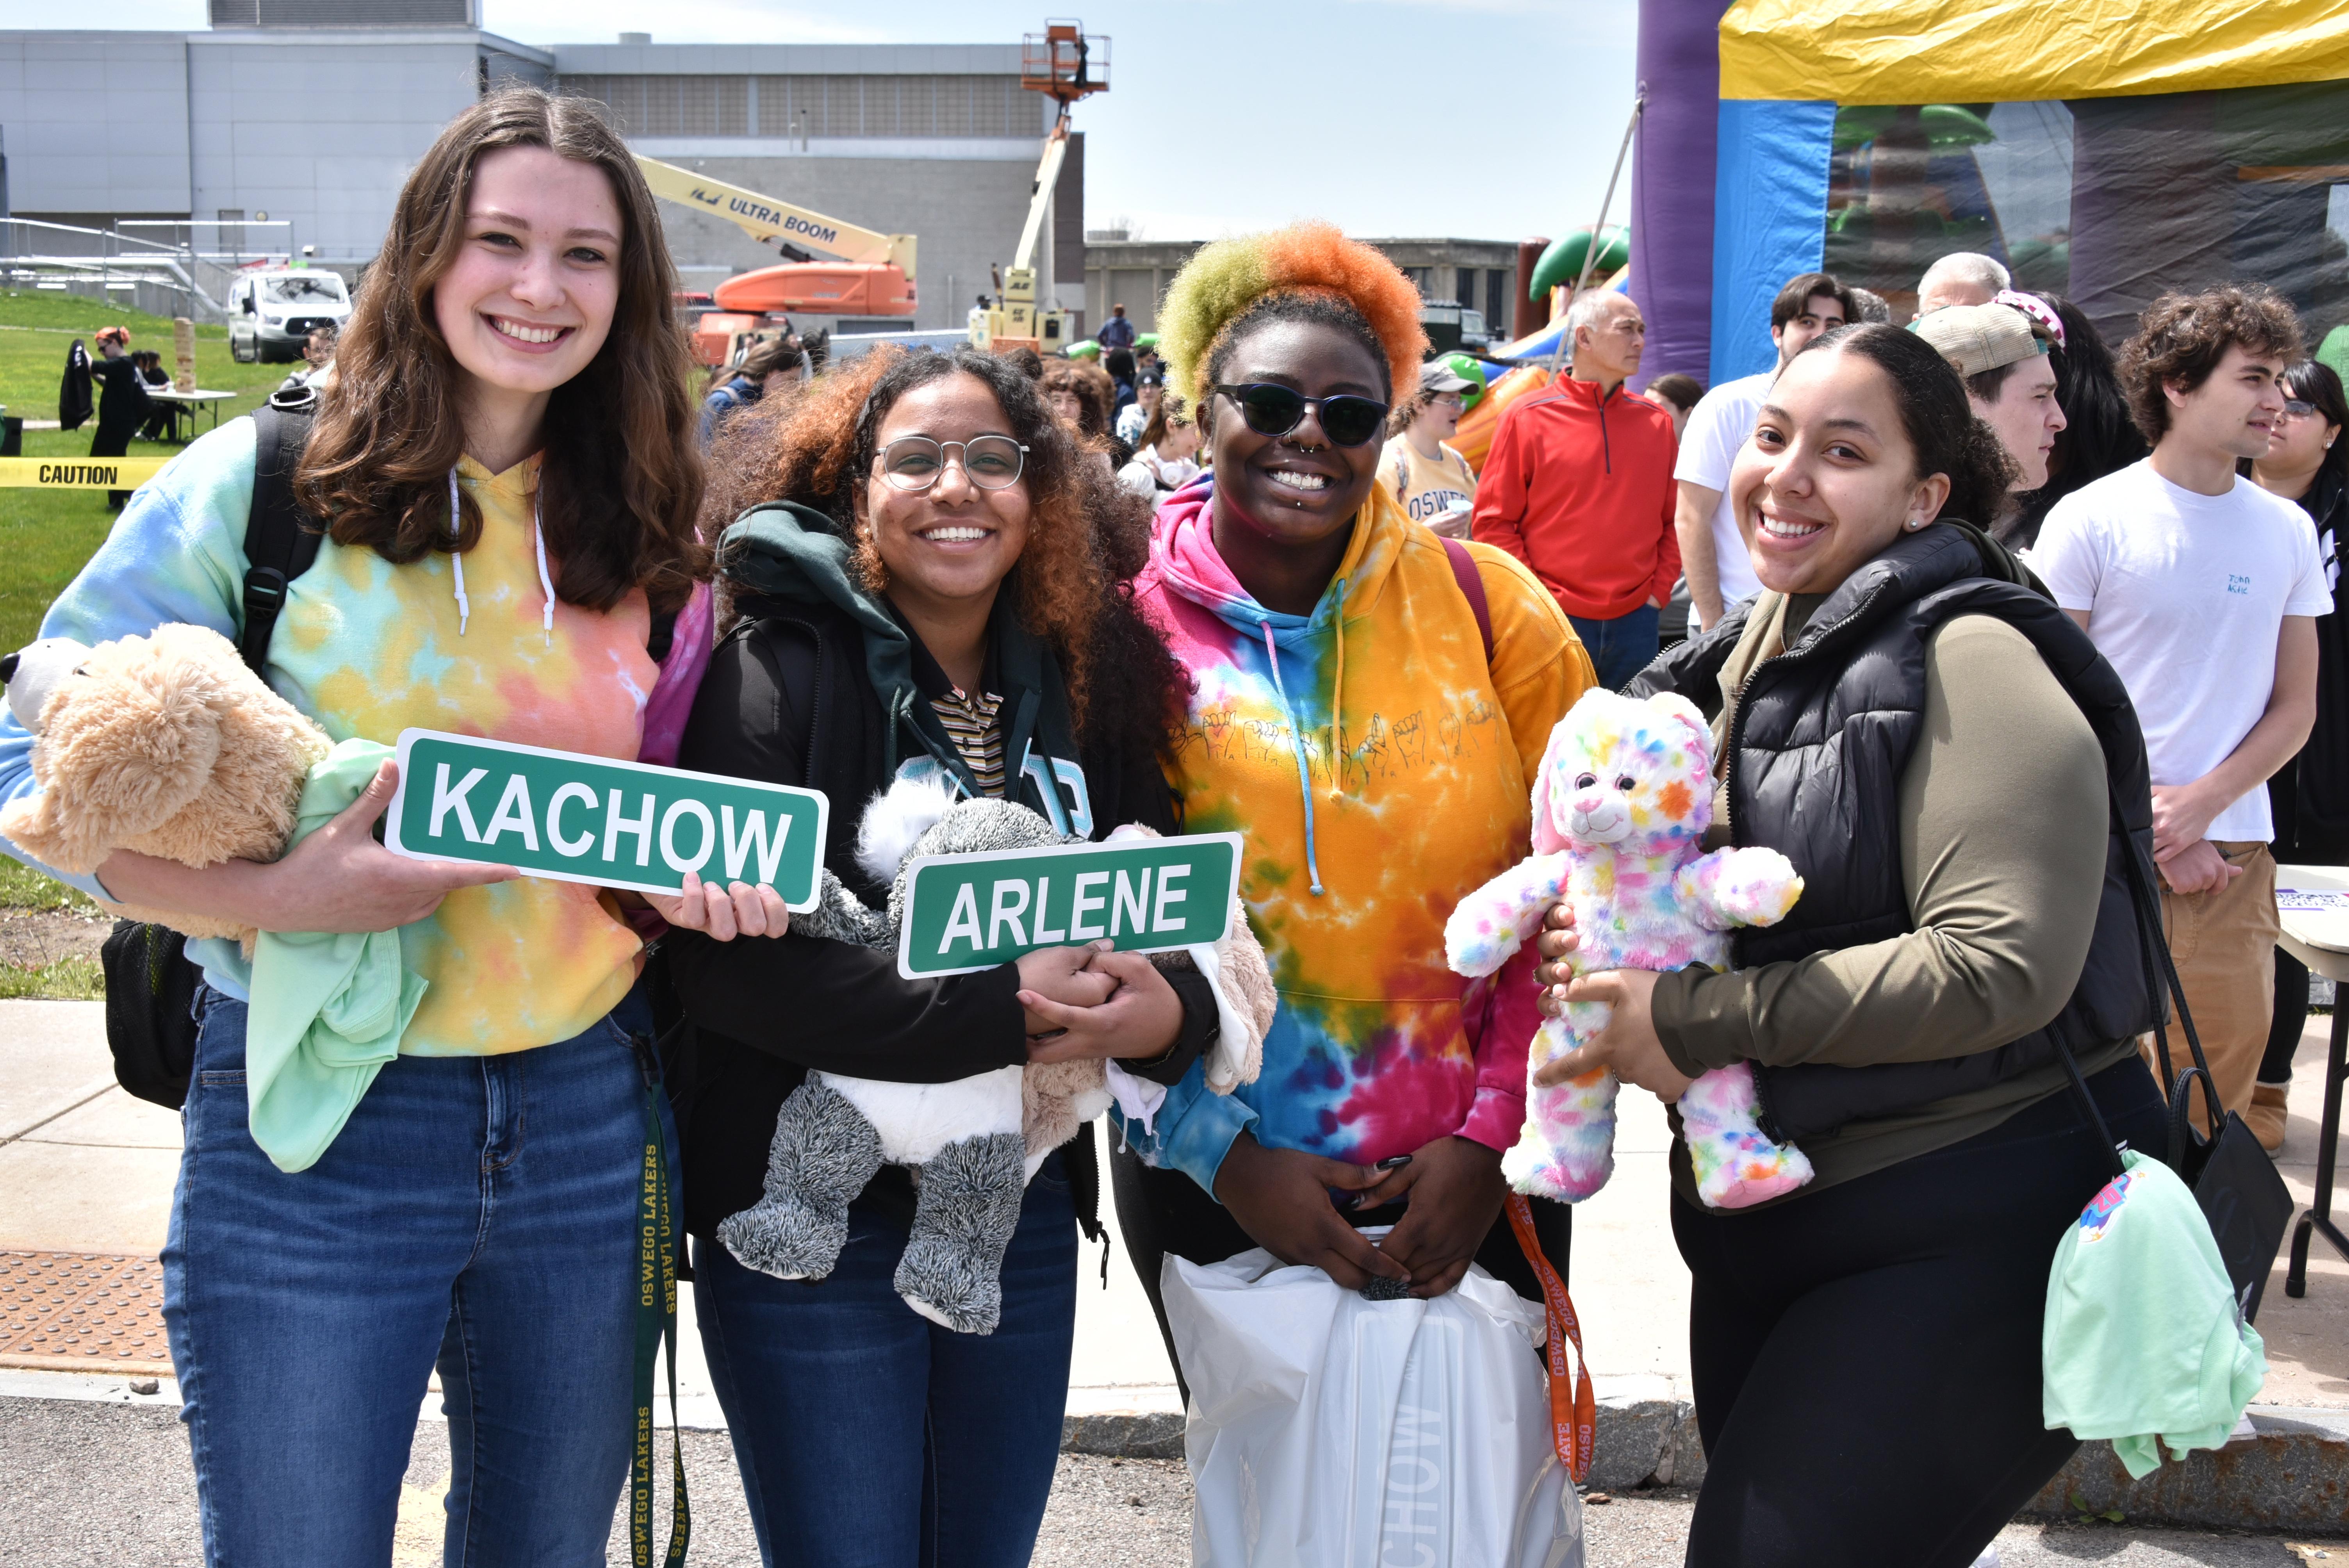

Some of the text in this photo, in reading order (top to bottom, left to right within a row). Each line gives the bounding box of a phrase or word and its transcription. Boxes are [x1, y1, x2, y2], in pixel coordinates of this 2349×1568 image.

[729, 198, 837, 243] ULTRA BOOM
[39, 465, 117, 485] CAUTION
[428, 763, 793, 884] KACHOW
[937, 864, 1192, 954] ARLENE
[642, 1144, 656, 1306] OSWEGO LAKERS
[660, 1242, 676, 1314] LAKERS
[1543, 1266, 1576, 1329] OSWEGO
[1549, 1310, 1565, 1377] OSWEGO
[635, 1406, 649, 1566] OSWEGO LAKERS
[670, 1487, 686, 1558] LAKERS
